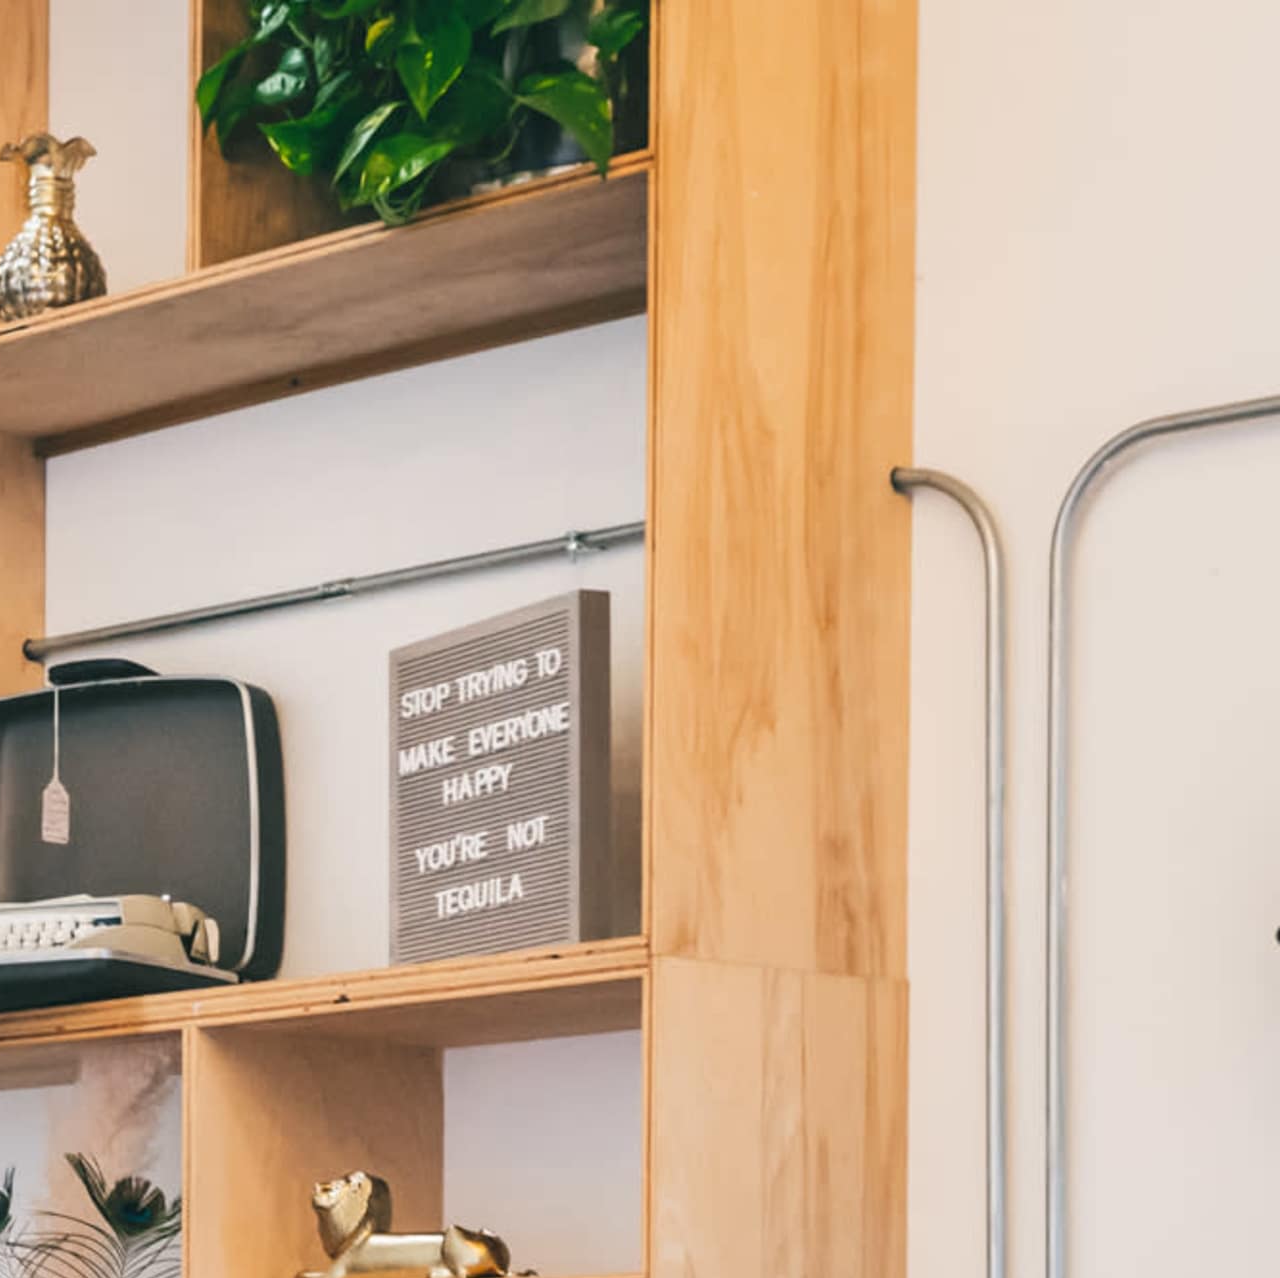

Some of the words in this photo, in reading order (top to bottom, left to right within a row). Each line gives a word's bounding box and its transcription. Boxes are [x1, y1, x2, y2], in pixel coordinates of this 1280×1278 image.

[401, 684, 450, 718] STOP
[456, 660, 528, 704] TRYING
[535, 649, 561, 677] TO
[399, 737, 456, 775] MAKE
[468, 703, 570, 756] EVERYONE
[442, 764, 513, 805] HAPPY
[415, 832, 489, 873] YOU'RE
[507, 816, 549, 850] NOT
[434, 873, 522, 917] TEQUILA
